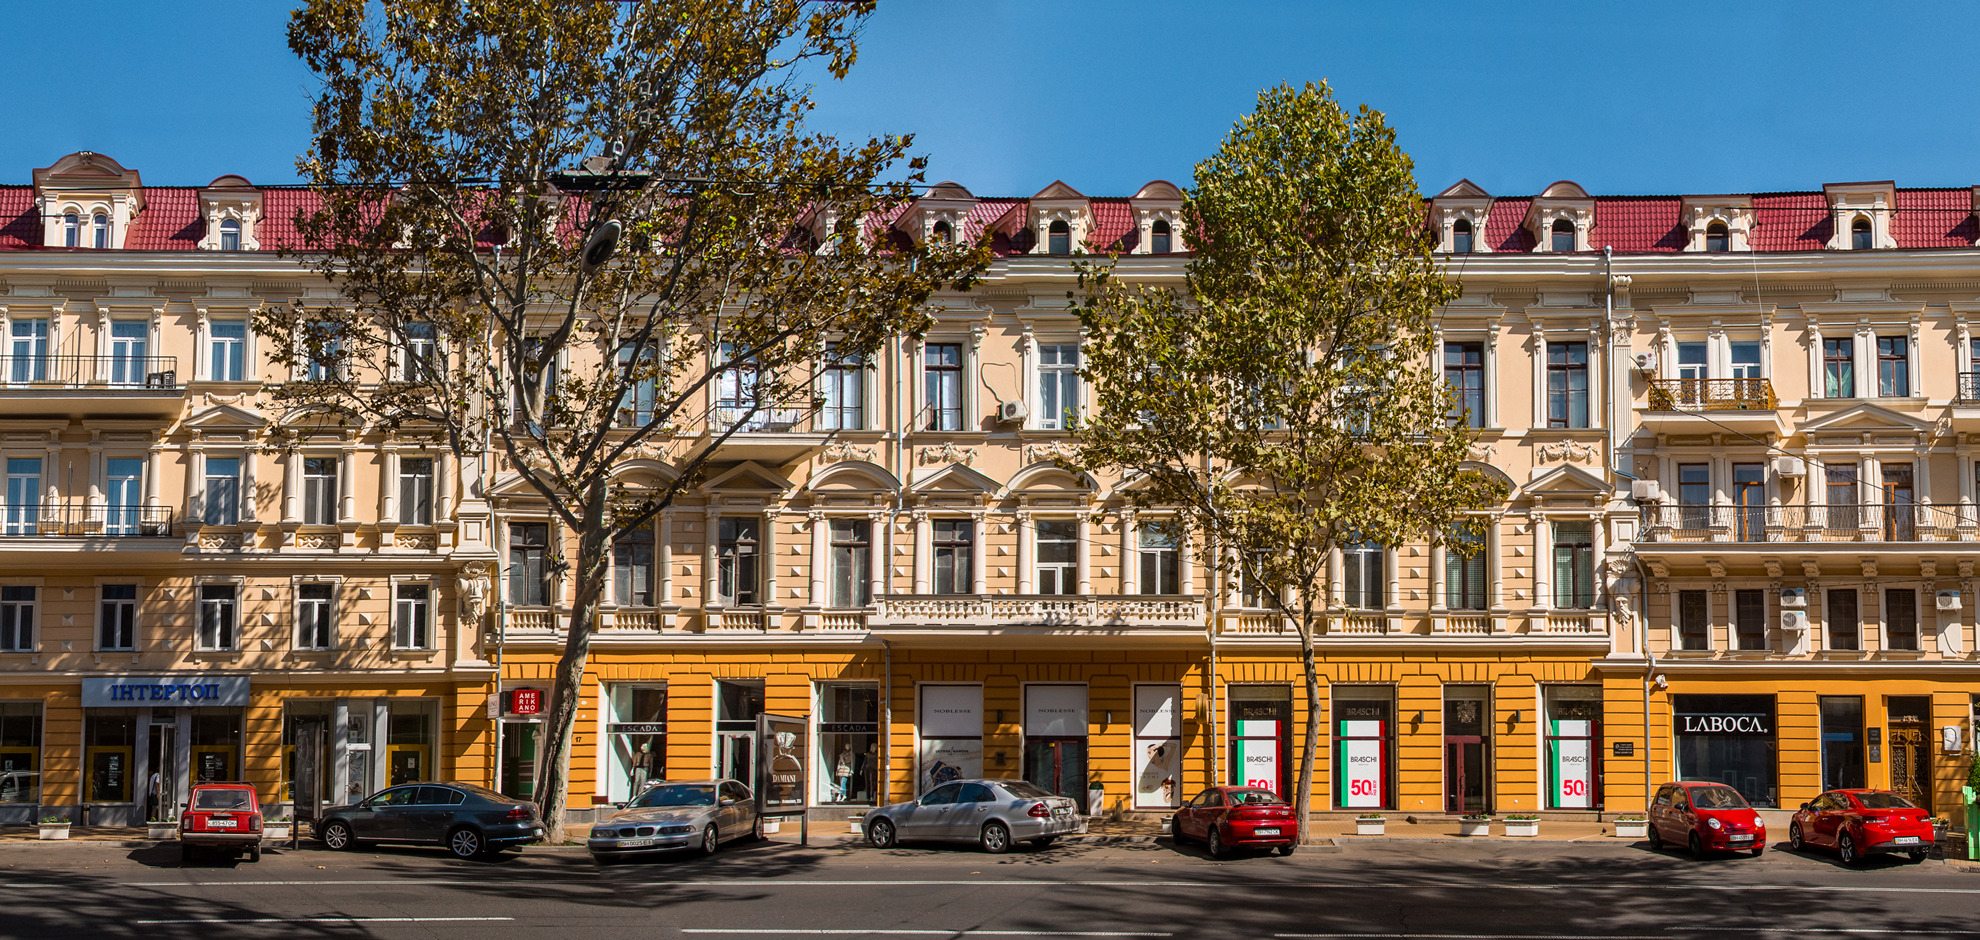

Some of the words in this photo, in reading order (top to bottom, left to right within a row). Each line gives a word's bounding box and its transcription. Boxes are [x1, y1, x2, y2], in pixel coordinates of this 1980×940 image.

[111, 684, 220, 700] ІНТЕРТОП
[1244, 707, 1277, 716] BRASCHI
[1347, 708, 1379, 716] BRASCHI
[772, 775, 796, 783] DAMIANI
